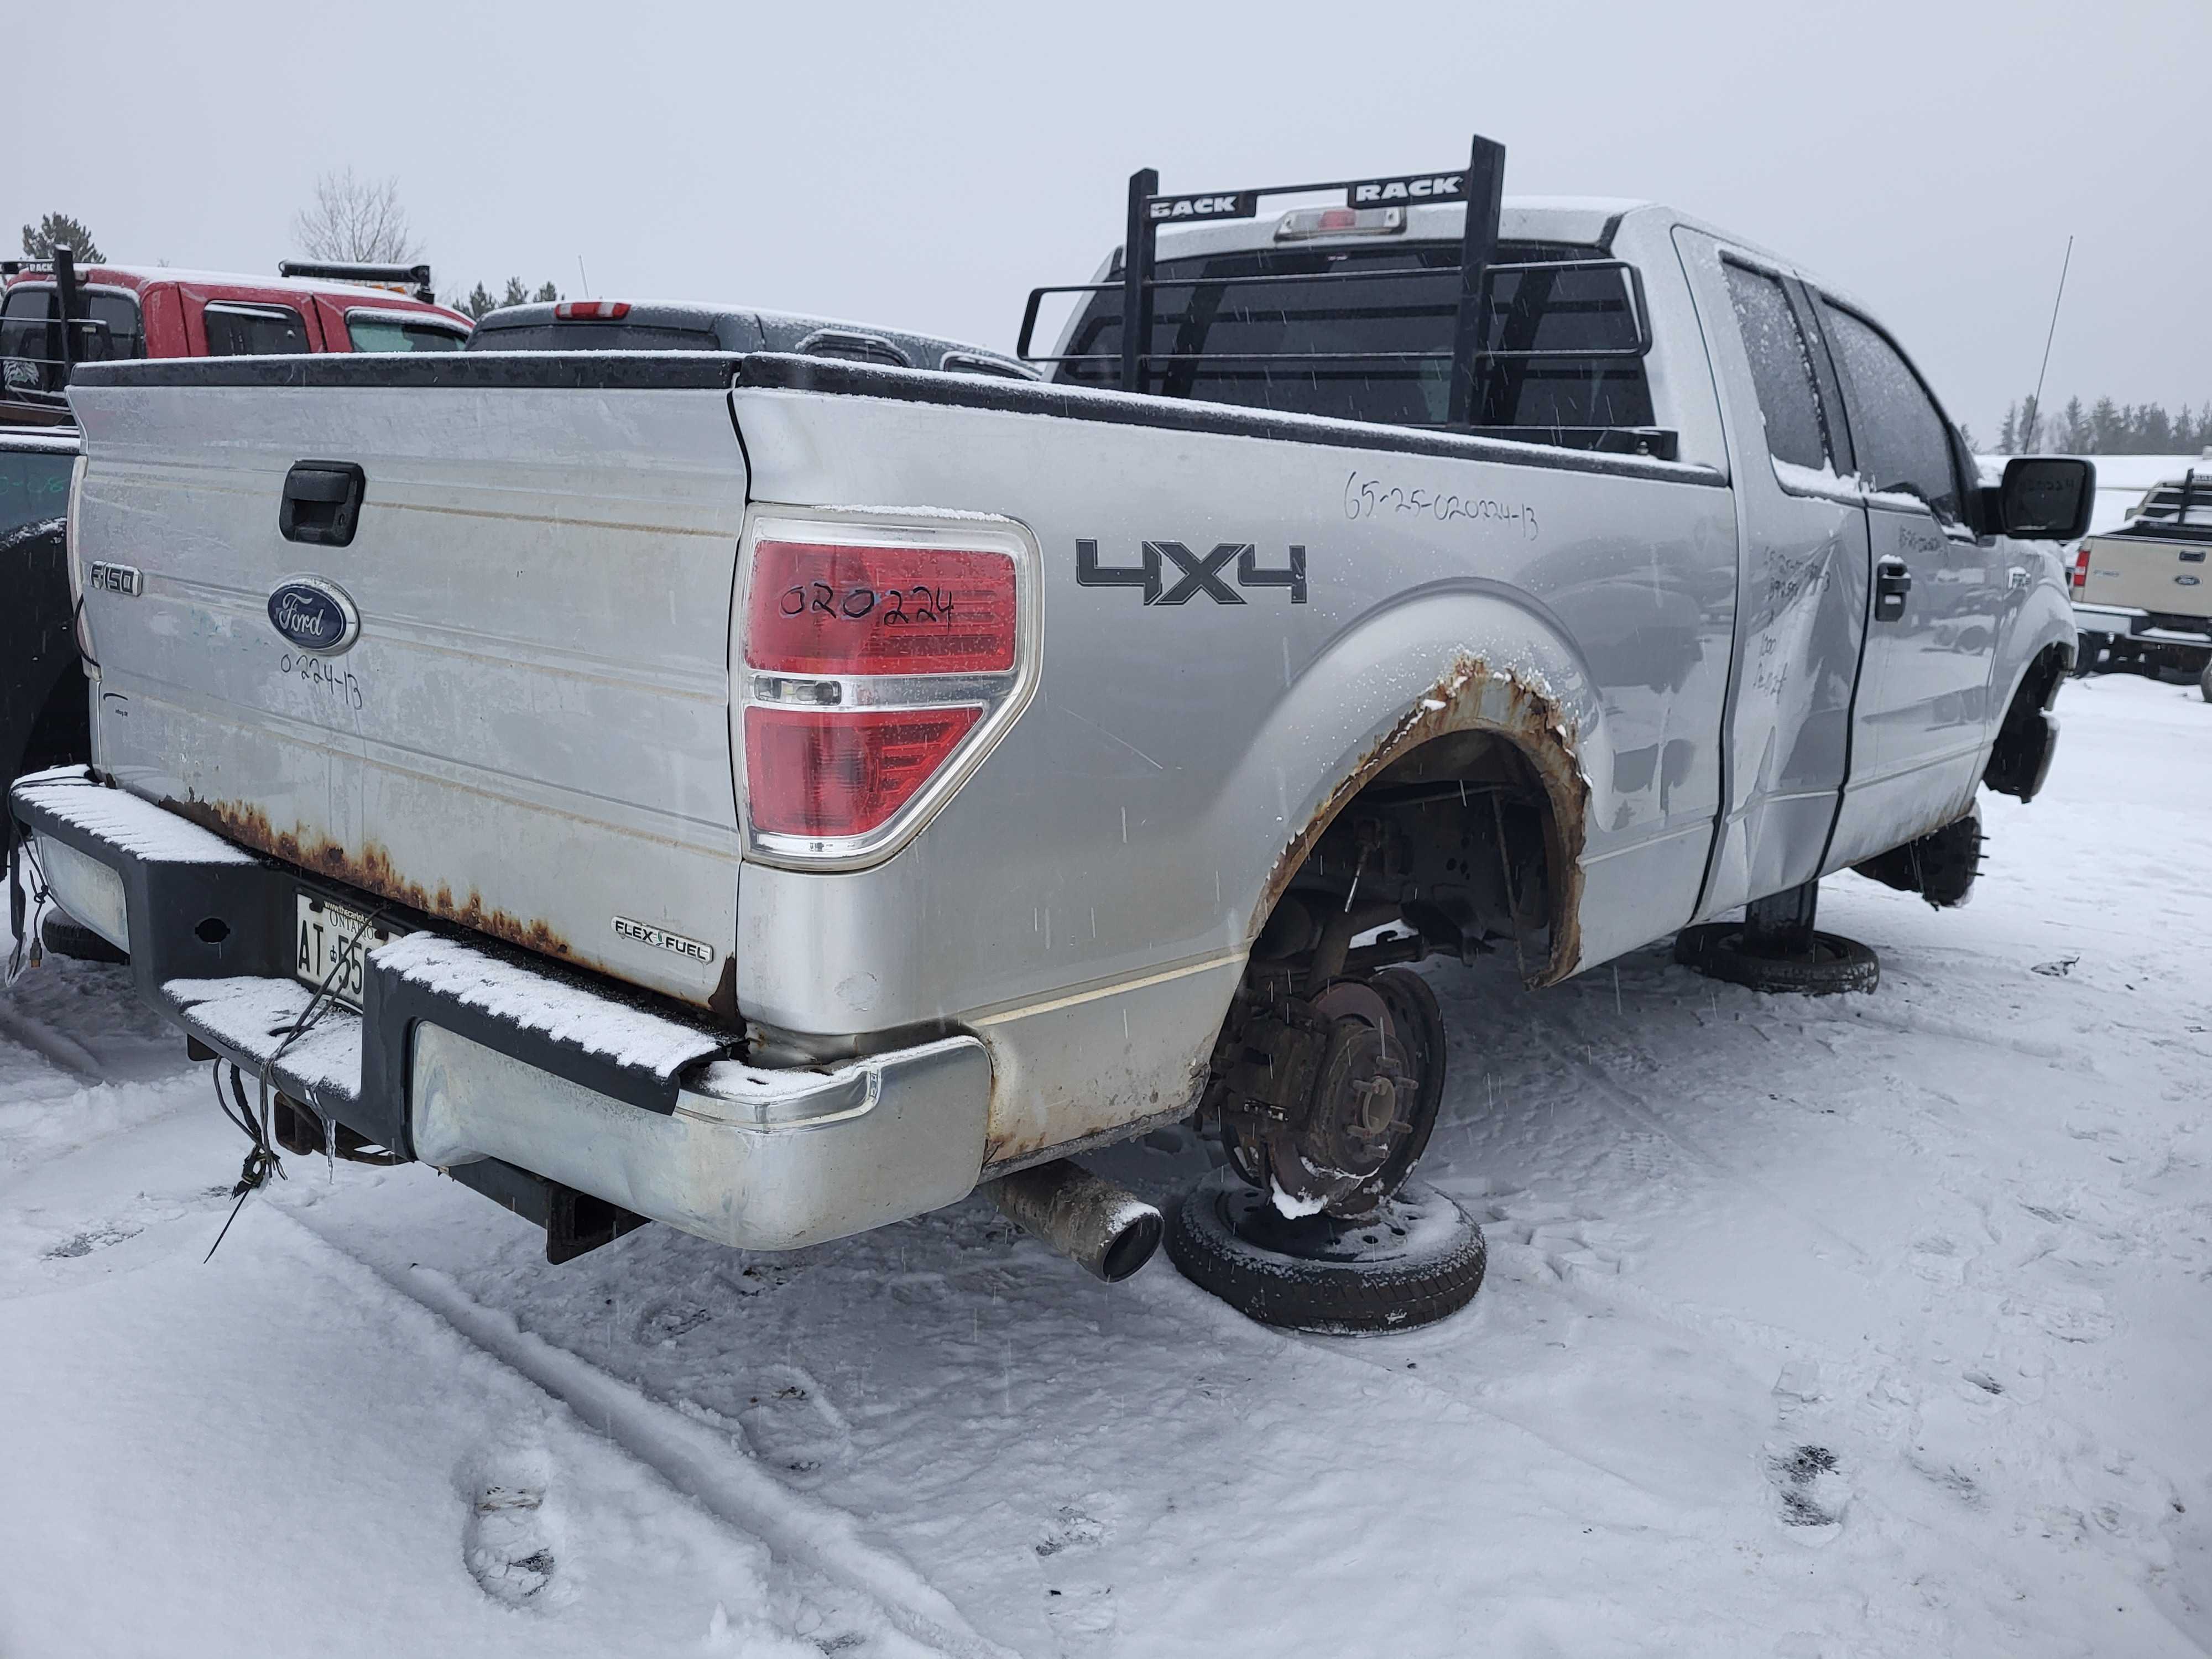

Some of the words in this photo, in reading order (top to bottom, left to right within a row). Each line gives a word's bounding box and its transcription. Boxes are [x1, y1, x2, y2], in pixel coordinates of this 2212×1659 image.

[1355, 175, 1464, 202] RACK
[1076, 539, 1307, 606] 4X4
[278, 592, 325, 636] Ford
[780, 582, 954, 632] 020224
[299, 920, 324, 977] AT
[338, 935, 373, 994] 55
[615, 920, 654, 943] FLEX
[666, 937, 706, 960] FUEL
